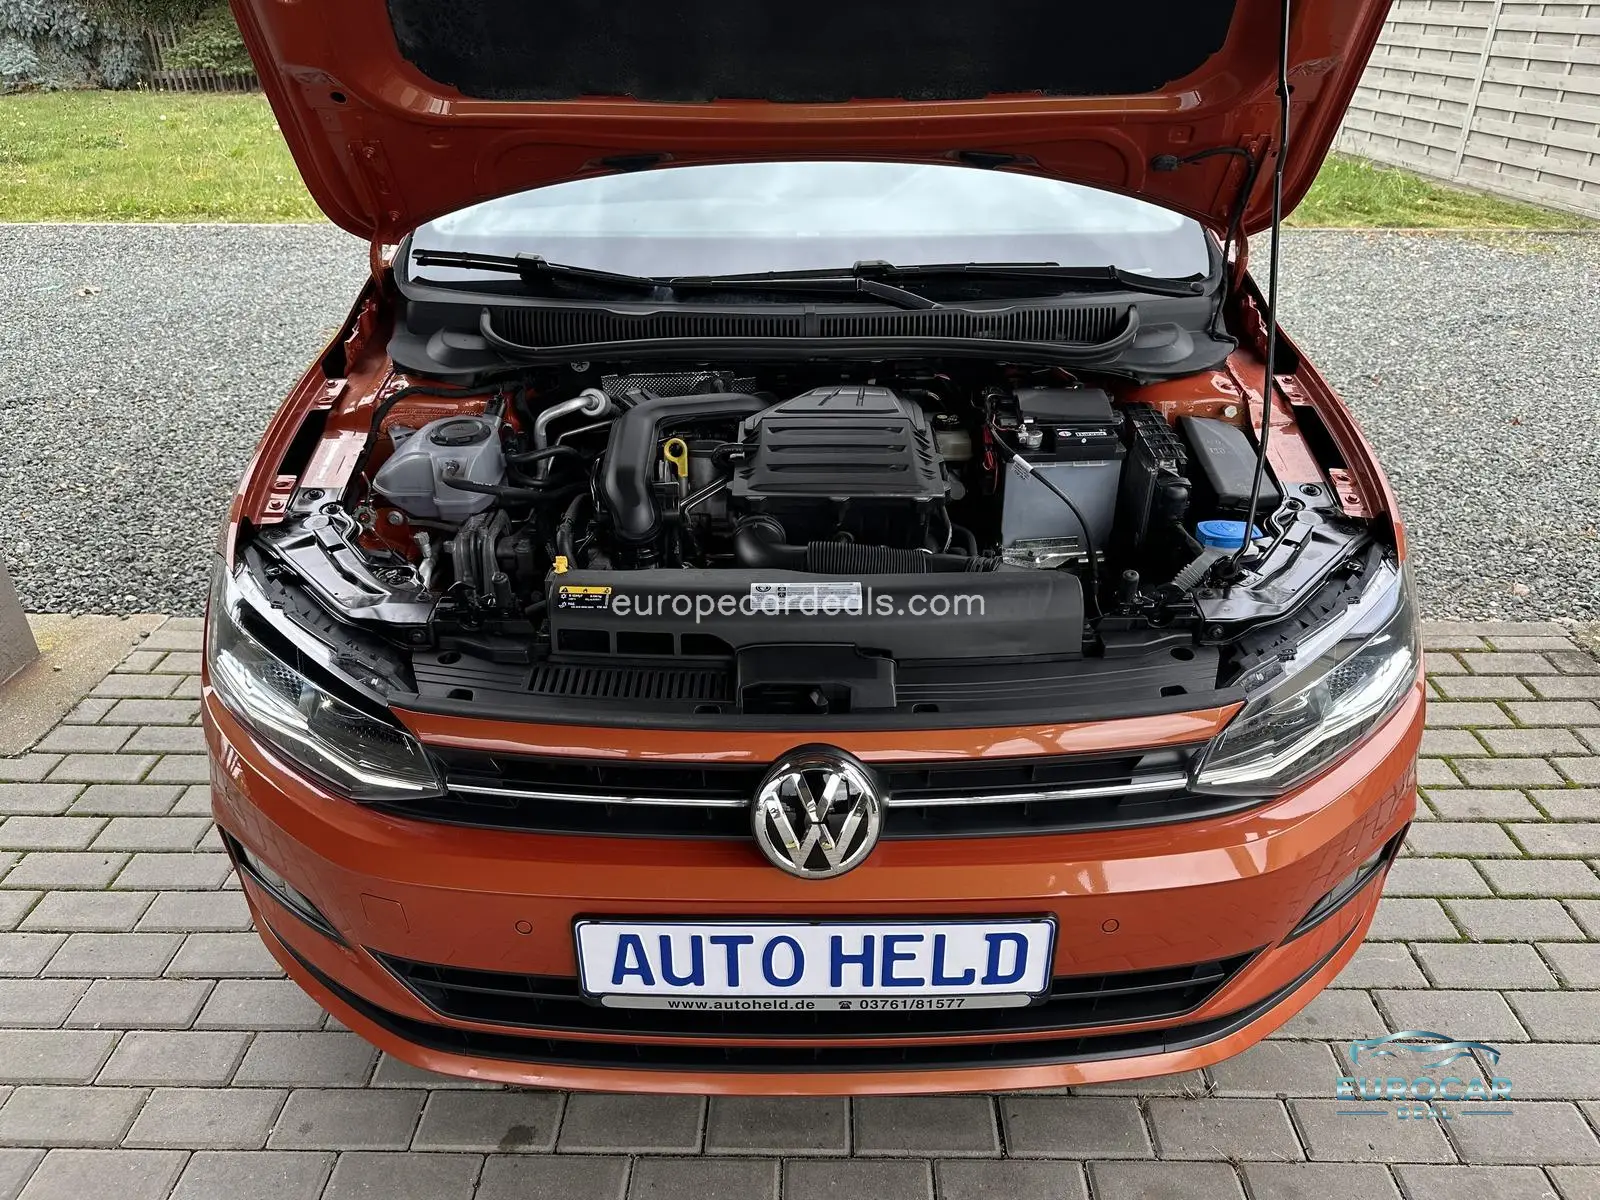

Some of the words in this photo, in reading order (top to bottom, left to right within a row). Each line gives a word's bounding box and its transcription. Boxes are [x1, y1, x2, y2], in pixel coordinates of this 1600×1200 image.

[611, 933, 805, 987] AUTO
[829, 932, 1029, 987] HELD
[668, 998, 815, 1011] www.autoheld.de
[859, 998, 966, 1011] 03761/81577
